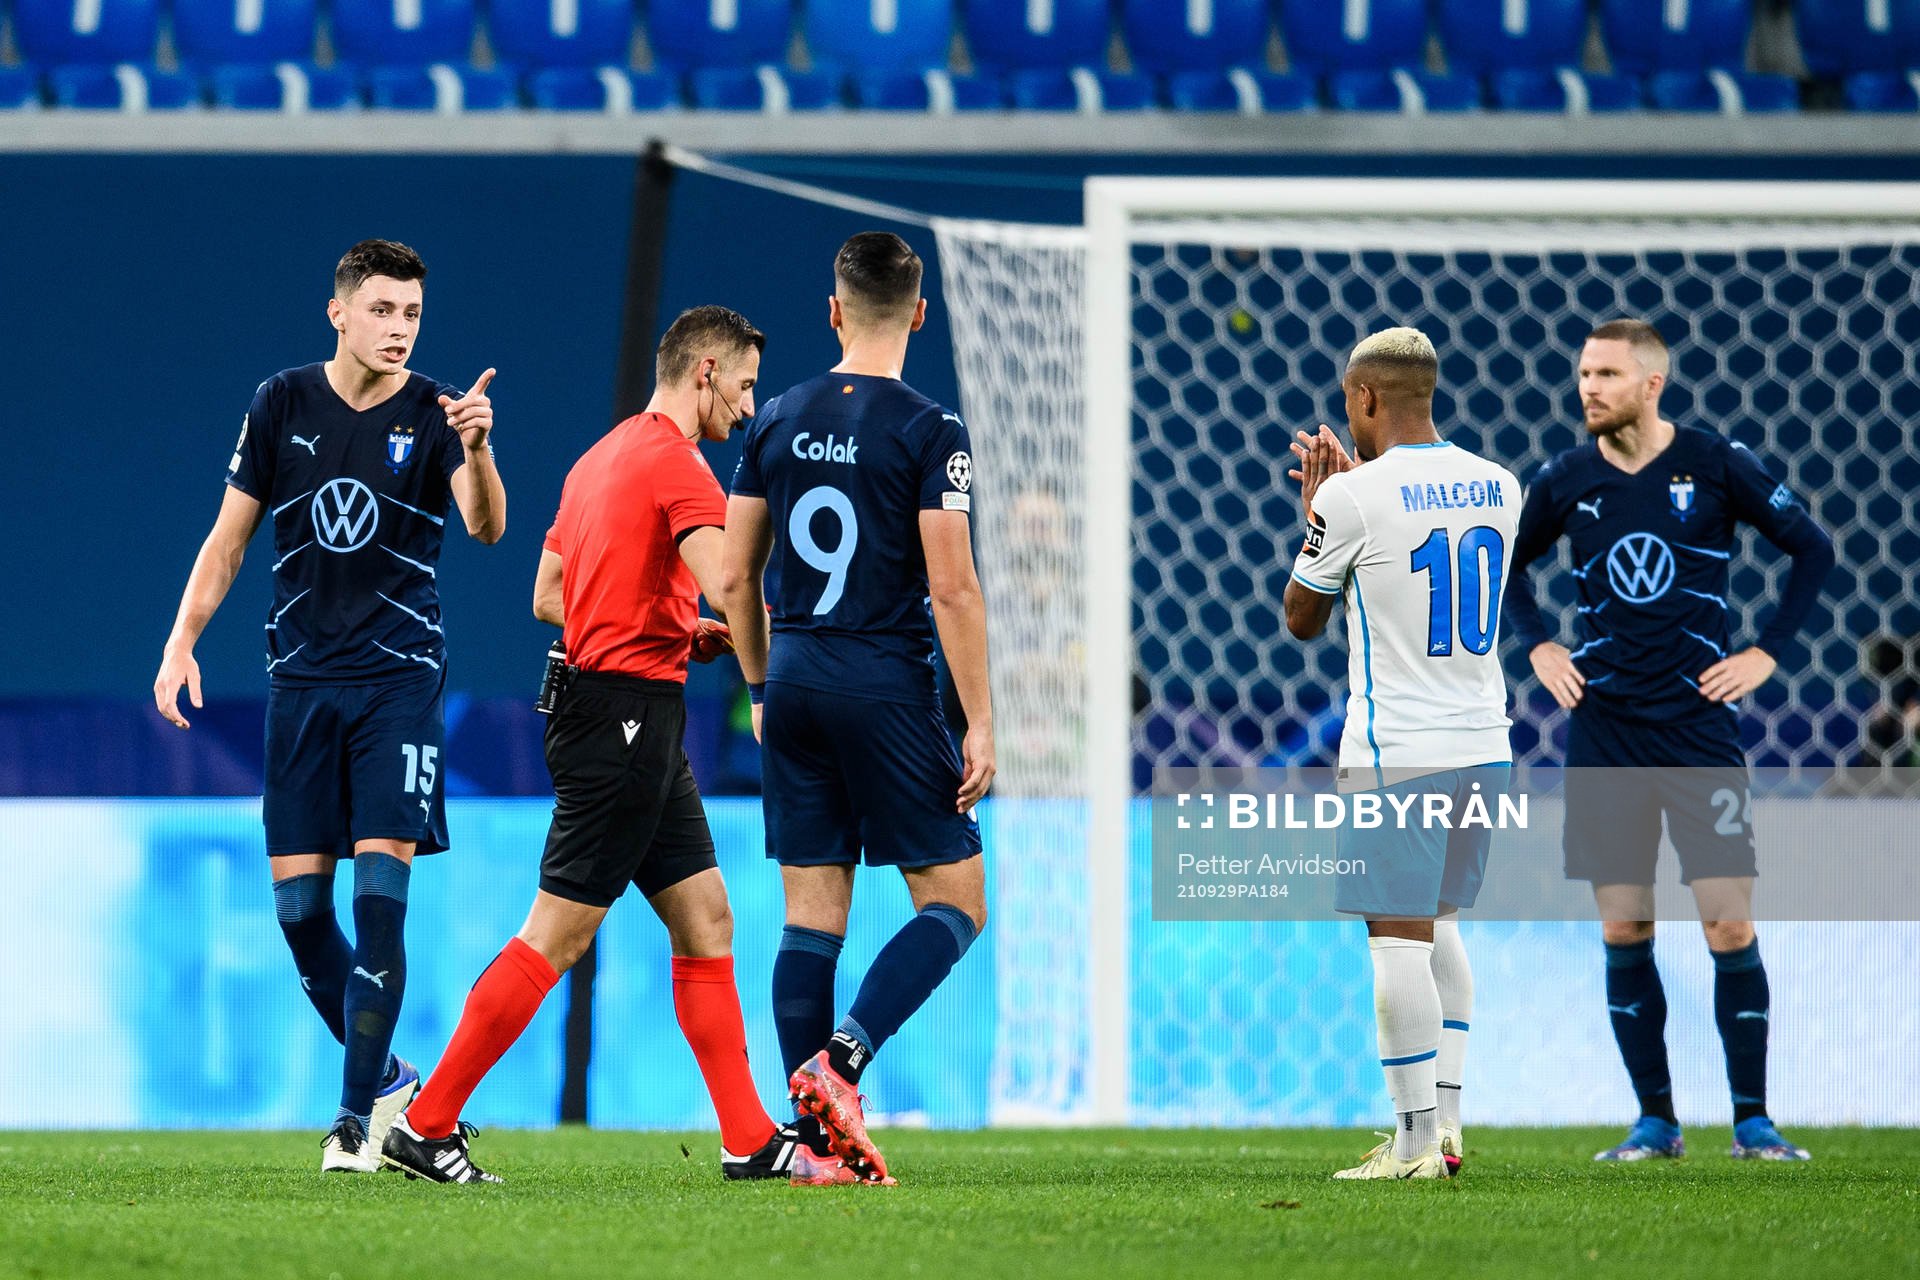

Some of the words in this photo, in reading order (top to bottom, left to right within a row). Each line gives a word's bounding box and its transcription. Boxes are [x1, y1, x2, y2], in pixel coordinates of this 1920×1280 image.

[792, 432, 859, 464] Colak
[1400, 480, 1504, 512] MALCOM
[789, 486, 858, 615] 9
[1410, 525, 1505, 657] 10
[402, 744, 438, 795] 15
